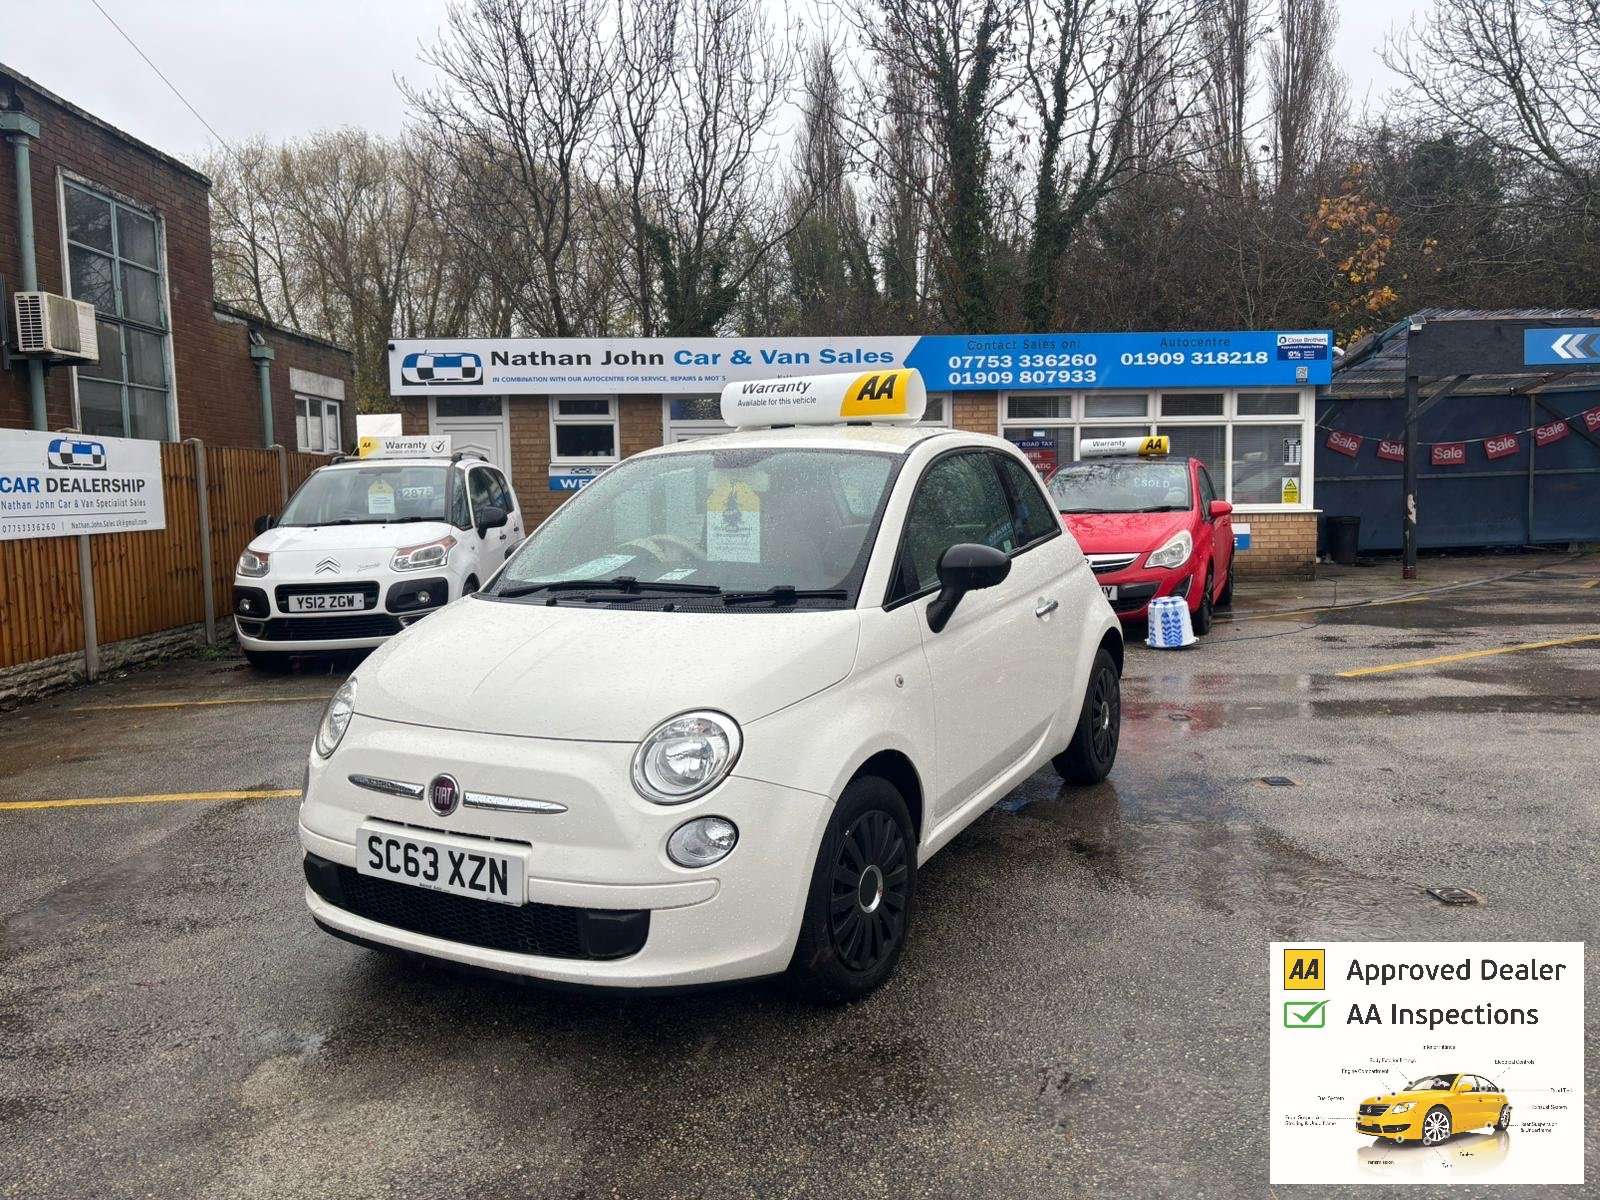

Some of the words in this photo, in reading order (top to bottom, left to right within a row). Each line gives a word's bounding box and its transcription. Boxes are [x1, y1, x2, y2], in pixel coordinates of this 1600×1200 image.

[967, 340, 1017, 350] Contact
[1023, 339, 1056, 350] Sales
[1160, 337, 1232, 347] Autocentre
[491, 350, 592, 366] Nathan
[601, 350, 665, 366] John
[674, 349, 722, 366] Car
[730, 349, 753, 365] &
[760, 349, 810, 365] Van
[819, 348, 894, 365] Sales
[948, 355, 1013, 369] 07753
[1018, 353, 1097, 368] 336260
[1120, 352, 1185, 366] 01909
[1190, 351, 1268, 365] 318218
[948, 371, 1013, 385] 01909
[1019, 370, 1097, 383] 807933
[741, 380, 812, 395] Warranty
[856, 374, 898, 401] AA
[737, 398, 767, 408] Available
[768, 398, 778, 406] for
[779, 397, 792, 406] this
[793, 396, 817, 405] vehicle
[1536, 420, 1565, 439] Sale
[385, 441, 427, 450] Warranty
[1092, 440, 1126, 449] Warranty
[1145, 438, 1162, 450] AA
[1330, 431, 1358, 451] Sale
[1487, 437, 1516, 453] Sale
[1432, 446, 1463, 460] Sale
[0, 477, 40, 493] CAR
[46, 477, 146, 493] DEALERSHIP
[1, 501, 32, 511] Nathan
[35, 500, 55, 510] John
[58, 500, 71, 509] Car
[74, 500, 79, 508] &
[82, 500, 94, 508] Van
[96, 499, 128, 508] Specialist
[130, 499, 146, 507] Sales
[296, 595, 326, 609] YS12
[329, 595, 355, 608] ZGW
[434, 786, 453, 807] FIAT
[368, 835, 439, 882] SC63
[448, 850, 508, 896] XZN
